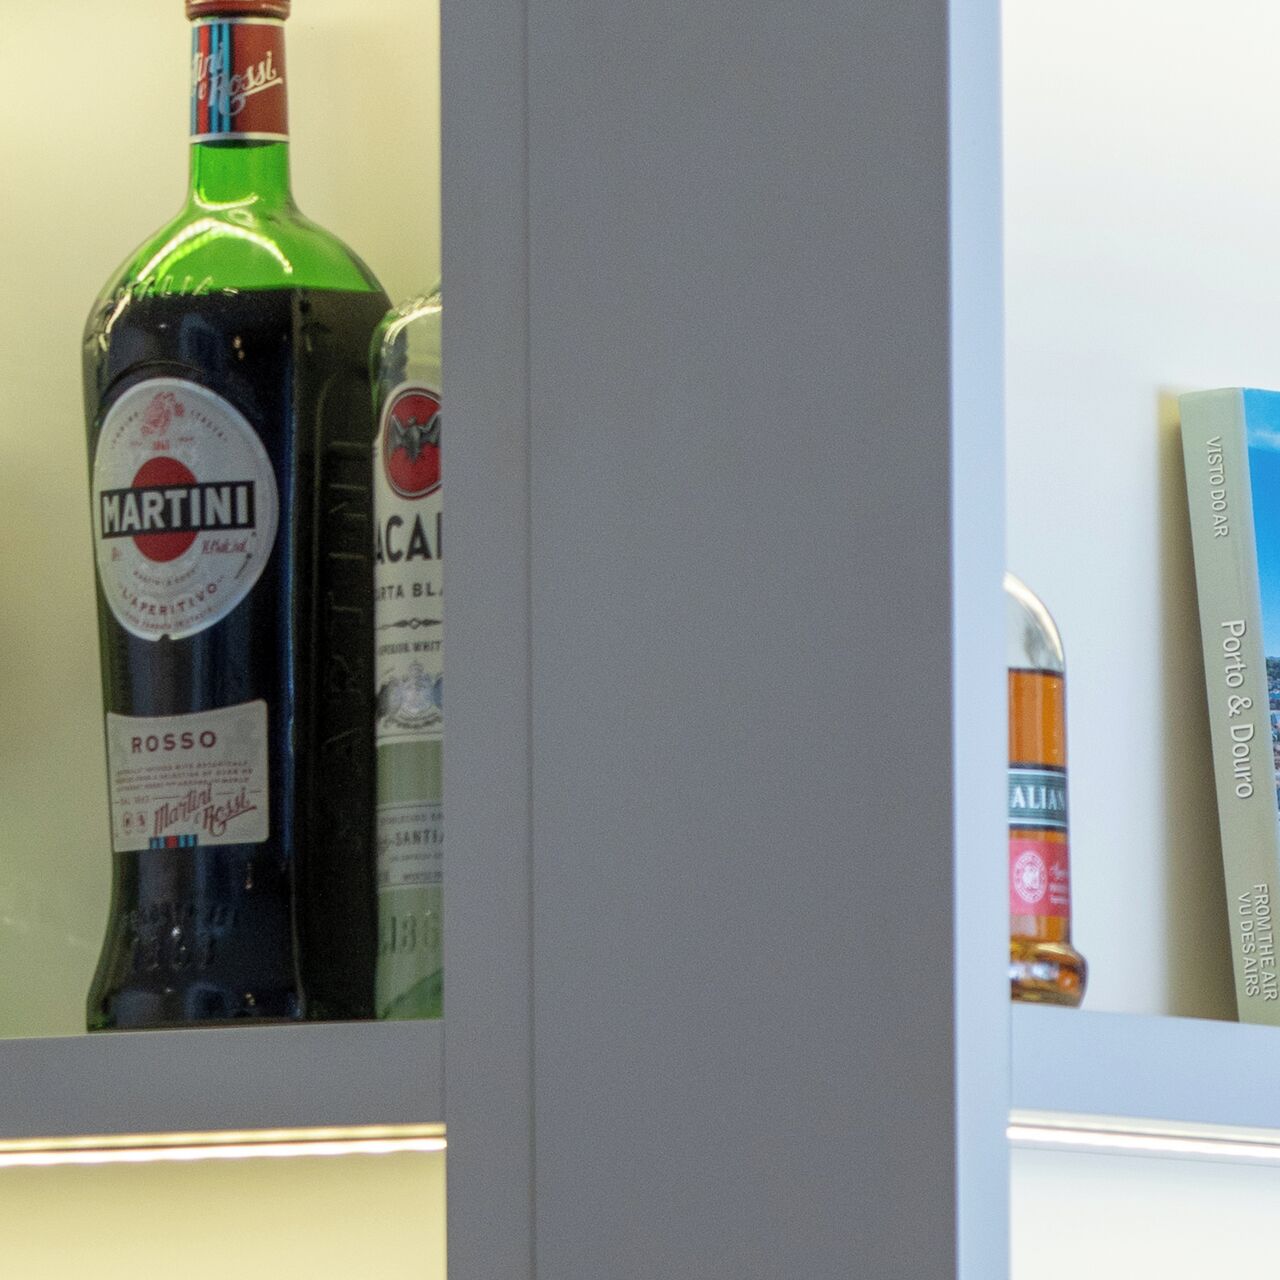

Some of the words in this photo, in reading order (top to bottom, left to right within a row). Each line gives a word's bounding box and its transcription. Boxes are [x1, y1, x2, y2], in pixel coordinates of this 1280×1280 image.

[1206, 435, 1225, 486] VISTO
[103, 486, 249, 535] MARTINI
[1211, 489, 1227, 511] DO
[1212, 514, 1229, 538] AR
[1221, 619, 1246, 689] Porto
[1227, 694, 1253, 717] &
[131, 730, 217, 753] ROSSO
[1230, 723, 1255, 799] Douro
[1238, 891, 1252, 917] VU
[1253, 883, 1272, 932] FROM
[1240, 920, 1256, 954] DES
[1258, 932, 1275, 969] THE
[1242, 956, 1260, 997] AIRS
[1261, 971, 1279, 1001] AIR
